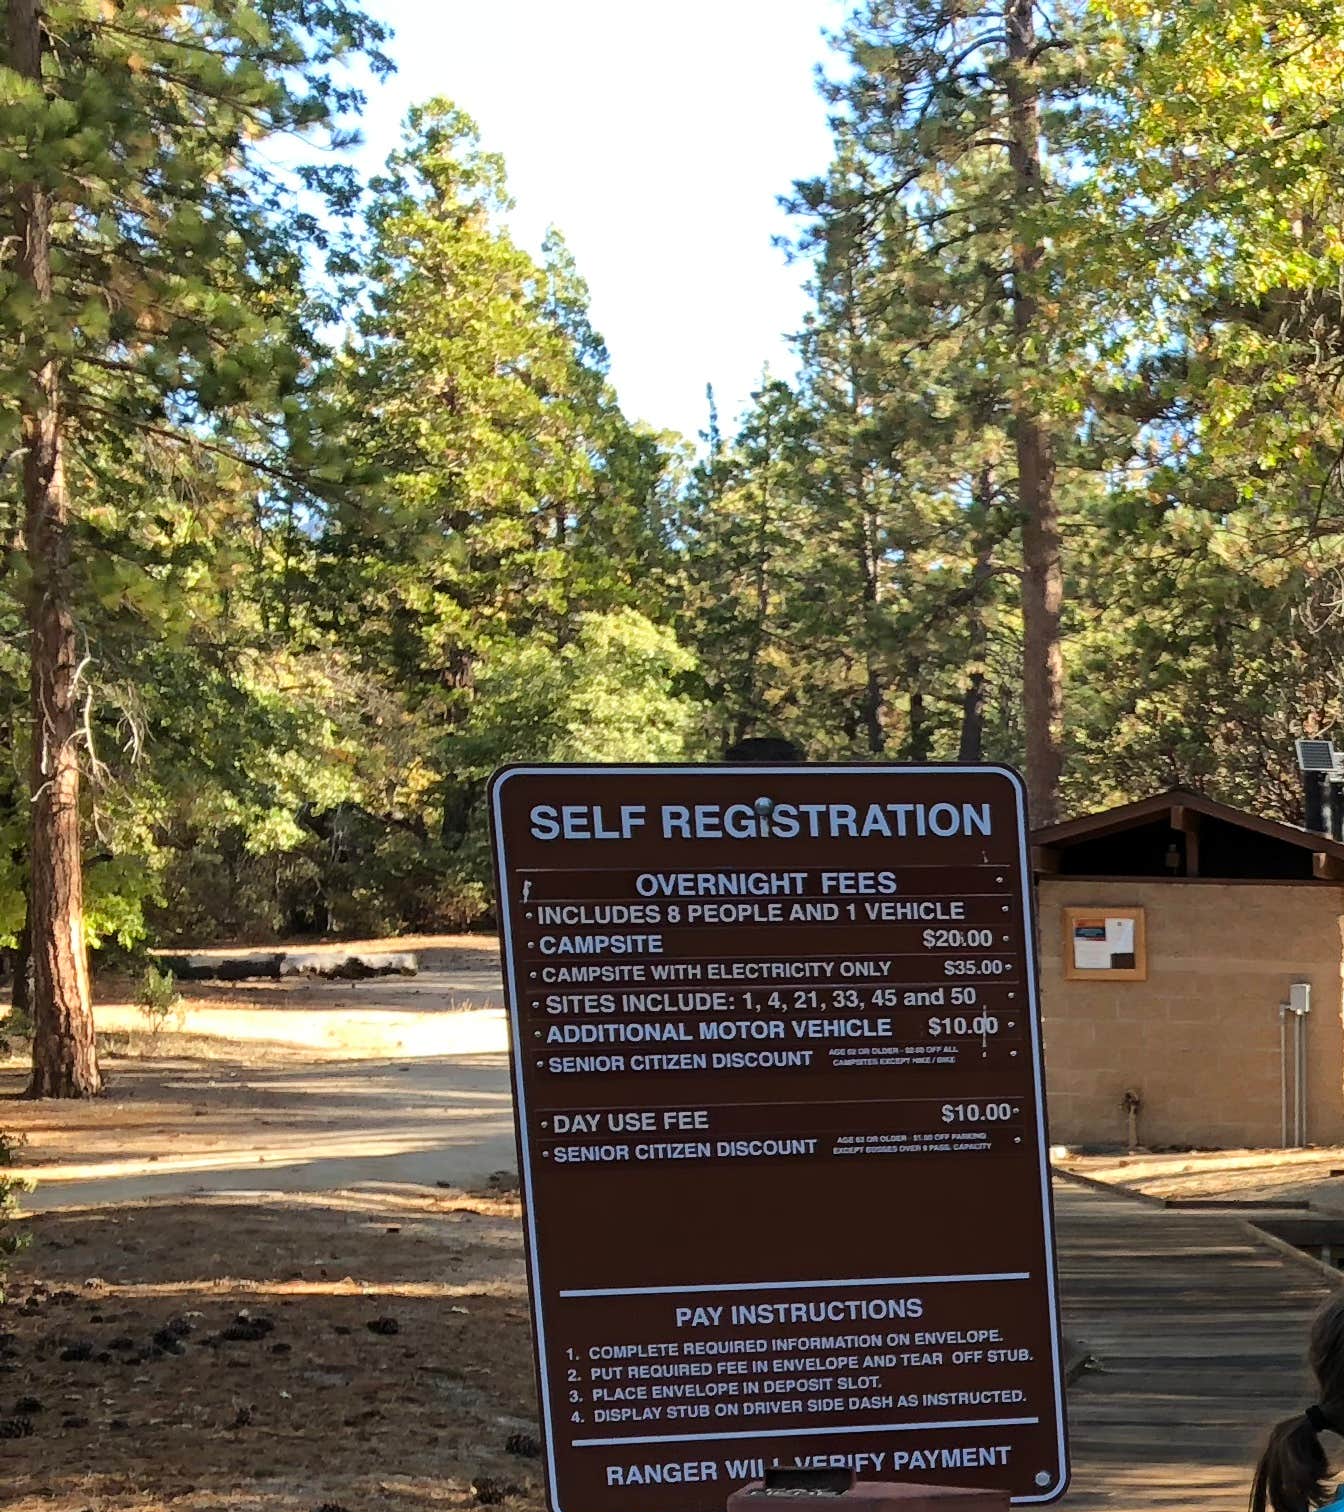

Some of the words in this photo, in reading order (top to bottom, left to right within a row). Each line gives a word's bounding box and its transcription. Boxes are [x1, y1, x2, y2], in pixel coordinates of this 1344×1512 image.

[530, 805, 646, 839] SELF
[661, 803, 992, 839] REGISTRATION
[635, 872, 807, 896] OVERNIGHT
[821, 872, 897, 894] FEES
[537, 905, 661, 925] INCLUDES
[667, 905, 680, 923] 8
[688, 903, 783, 922] PEOPLE
[789, 903, 838, 921] AND
[846, 903, 856, 920] 1
[865, 901, 965, 920] VEHICLE
[539, 934, 663, 954] CAMPSITE
[923, 929, 992, 949] $20.00
[542, 965, 645, 983] CAMPSITE
[650, 964, 701, 981] WITH
[707, 961, 833, 979] ELECTRICITY
[839, 960, 891, 977] ONLY
[944, 960, 1002, 976] $35.00
[546, 995, 615, 1014] SITES
[622, 992, 735, 1014] INCLUDE:
[742, 991, 761, 1012] 1,
[768, 991, 787, 1012] 4,
[794, 990, 826, 1011] 21,
[832, 990, 865, 1010] 33,
[872, 989, 897, 1006] 45
[904, 987, 944, 1006] and
[950, 987, 976, 1005] 50
[547, 1023, 693, 1044] ADDITIONAL
[699, 1020, 785, 1040] MOTOR
[792, 1018, 892, 1038] VEHICLE
[928, 1016, 998, 1037] $10.00
[549, 1055, 625, 1073] SENIOR
[630, 1053, 706, 1071] CITIZEN
[712, 1050, 813, 1068] DISCOUNT
[554, 1113, 600, 1134] DAY
[608, 1112, 657, 1132] USE
[663, 1111, 709, 1130] FEE
[941, 1103, 1011, 1123] $10.00
[554, 1145, 629, 1163] SENIOR
[635, 1142, 711, 1161] CITIZEN
[716, 1139, 817, 1158] DISCOUNT
[675, 1306, 723, 1327] PAY
[731, 1298, 923, 1325] INSTRUCTIONS
[566, 1347, 580, 1360] 1.
[588, 1343, 679, 1360] COMPLETE
[683, 1339, 768, 1356] REQUIRED
[772, 1334, 882, 1352] INFORMATION
[886, 1333, 910, 1347] ON
[914, 1329, 1003, 1346] ENVELOPE.
[567, 1369, 582, 1382] 2.
[591, 1366, 623, 1381] PUT
[627, 1362, 712, 1379] REQUIRED
[717, 1361, 748, 1375] FEE
[752, 1359, 768, 1373] IN
[773, 1356, 858, 1373] ENVELOPE
[863, 1354, 897, 1369] AND
[900, 1352, 943, 1366] TEAR
[952, 1350, 983, 1364] OFF
[987, 1348, 1033, 1364] STUB.
[569, 1390, 583, 1403] 3.
[592, 1386, 647, 1402] PLACE
[652, 1382, 738, 1399] ENVELOPE
[743, 1380, 759, 1394] IN
[763, 1377, 833, 1393] DEPOSIT
[837, 1375, 882, 1391] SLOT.
[570, 1410, 585, 1424] 4.
[594, 1406, 662, 1423] DISPLAY
[666, 1404, 710, 1420] STUB
[714, 1403, 738, 1417] ON
[743, 1399, 803, 1416] DRIVER
[807, 1397, 844, 1412] SIDE
[849, 1395, 893, 1411] DASH
[897, 1394, 919, 1408] AS
[922, 1389, 1027, 1407] INSTRUCTED.
[606, 1461, 718, 1487] RANGER
[893, 1446, 1012, 1471] PAYMENT
